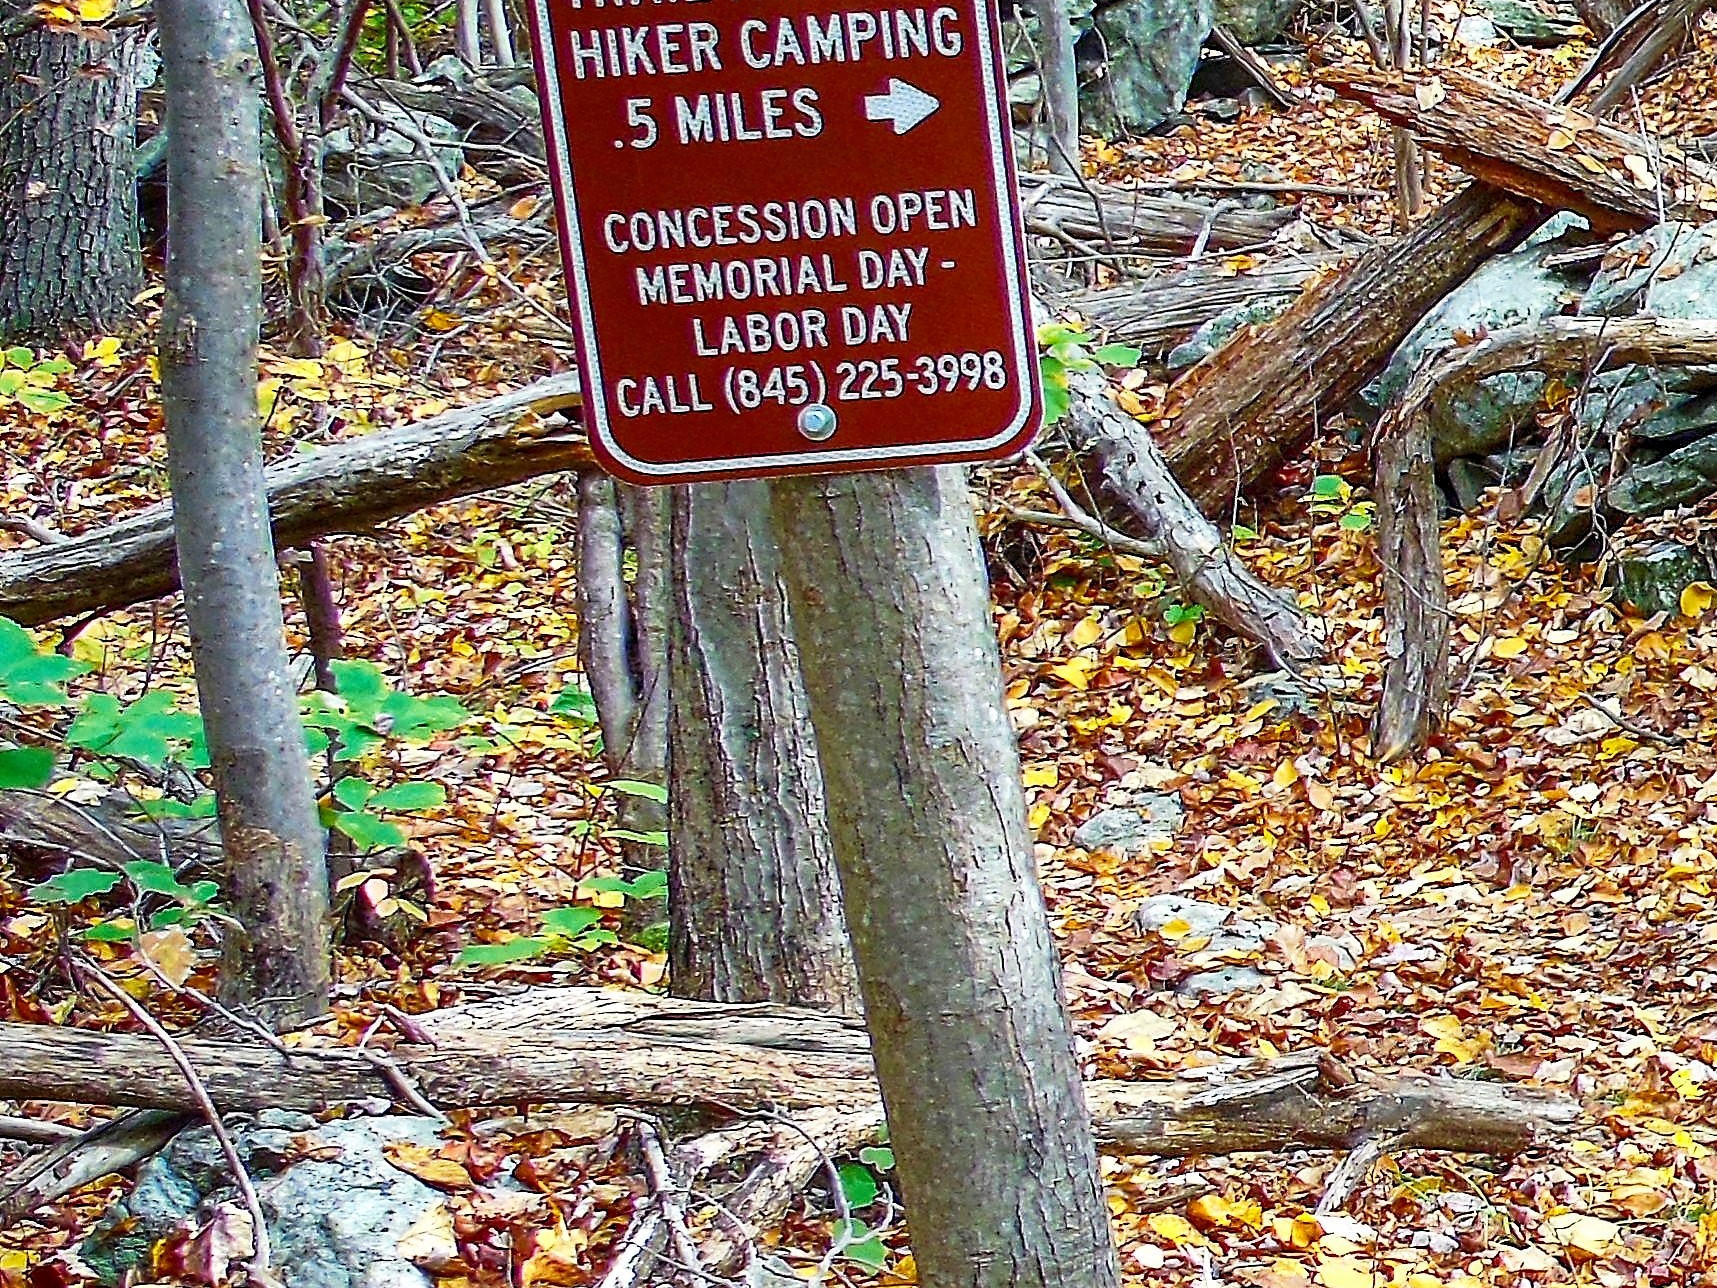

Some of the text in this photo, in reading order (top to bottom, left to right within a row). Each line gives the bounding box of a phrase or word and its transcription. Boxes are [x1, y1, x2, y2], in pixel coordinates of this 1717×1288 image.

[570, 6, 963, 80] HIKER CAMPING
[613, 87, 825, 150] .5 MILES
[603, 188, 977, 254] CONCESSION OPEN
[635, 253, 848, 307] MEMORIAL
[857, 247, 931, 290] DAY
[692, 302, 913, 357] LABOR DAY
[616, 350, 1008, 418] CALL (845) 225-3998
